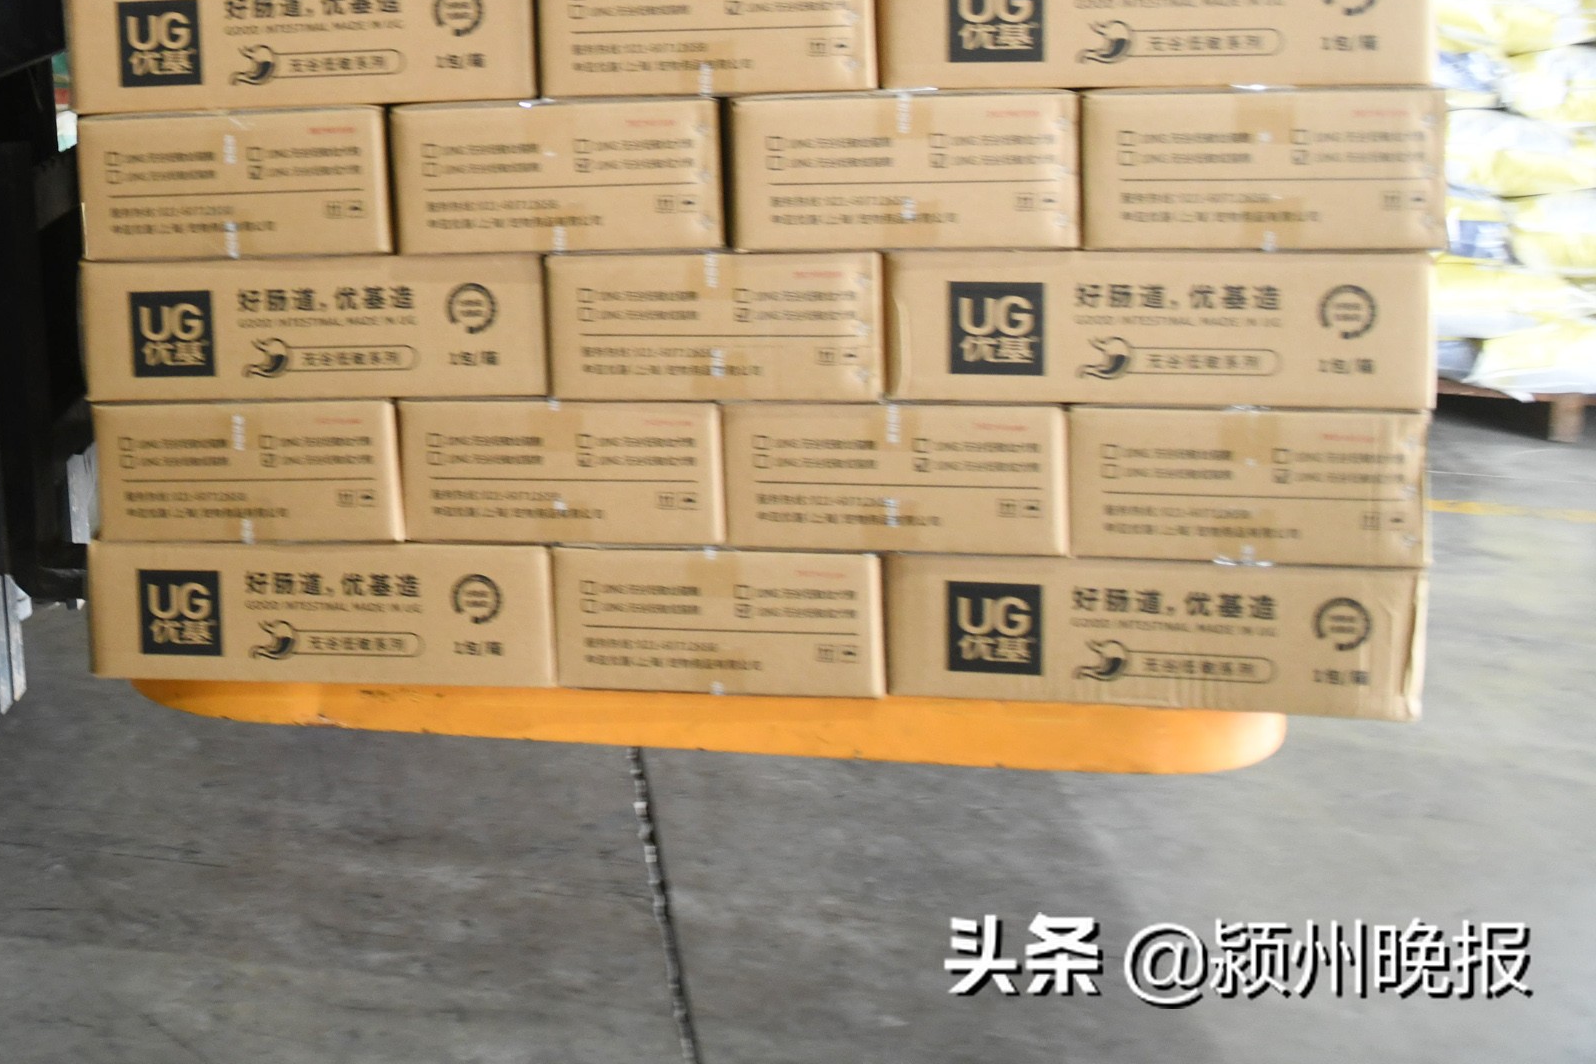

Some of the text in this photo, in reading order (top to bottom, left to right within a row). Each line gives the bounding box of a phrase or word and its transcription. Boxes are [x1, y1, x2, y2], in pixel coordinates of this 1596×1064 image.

[125, 11, 191, 50] UG
[961, 22, 1035, 51] 优基
[129, 50, 193, 75] 优基
[139, 303, 205, 341] UG
[958, 295, 1035, 336] UG
[142, 341, 207, 366] 优基
[960, 336, 1036, 364] 优基
[147, 582, 212, 620] UG
[957, 596, 1033, 636] UG
[150, 619, 213, 645] 优基
[959, 635, 1033, 662] 优基
